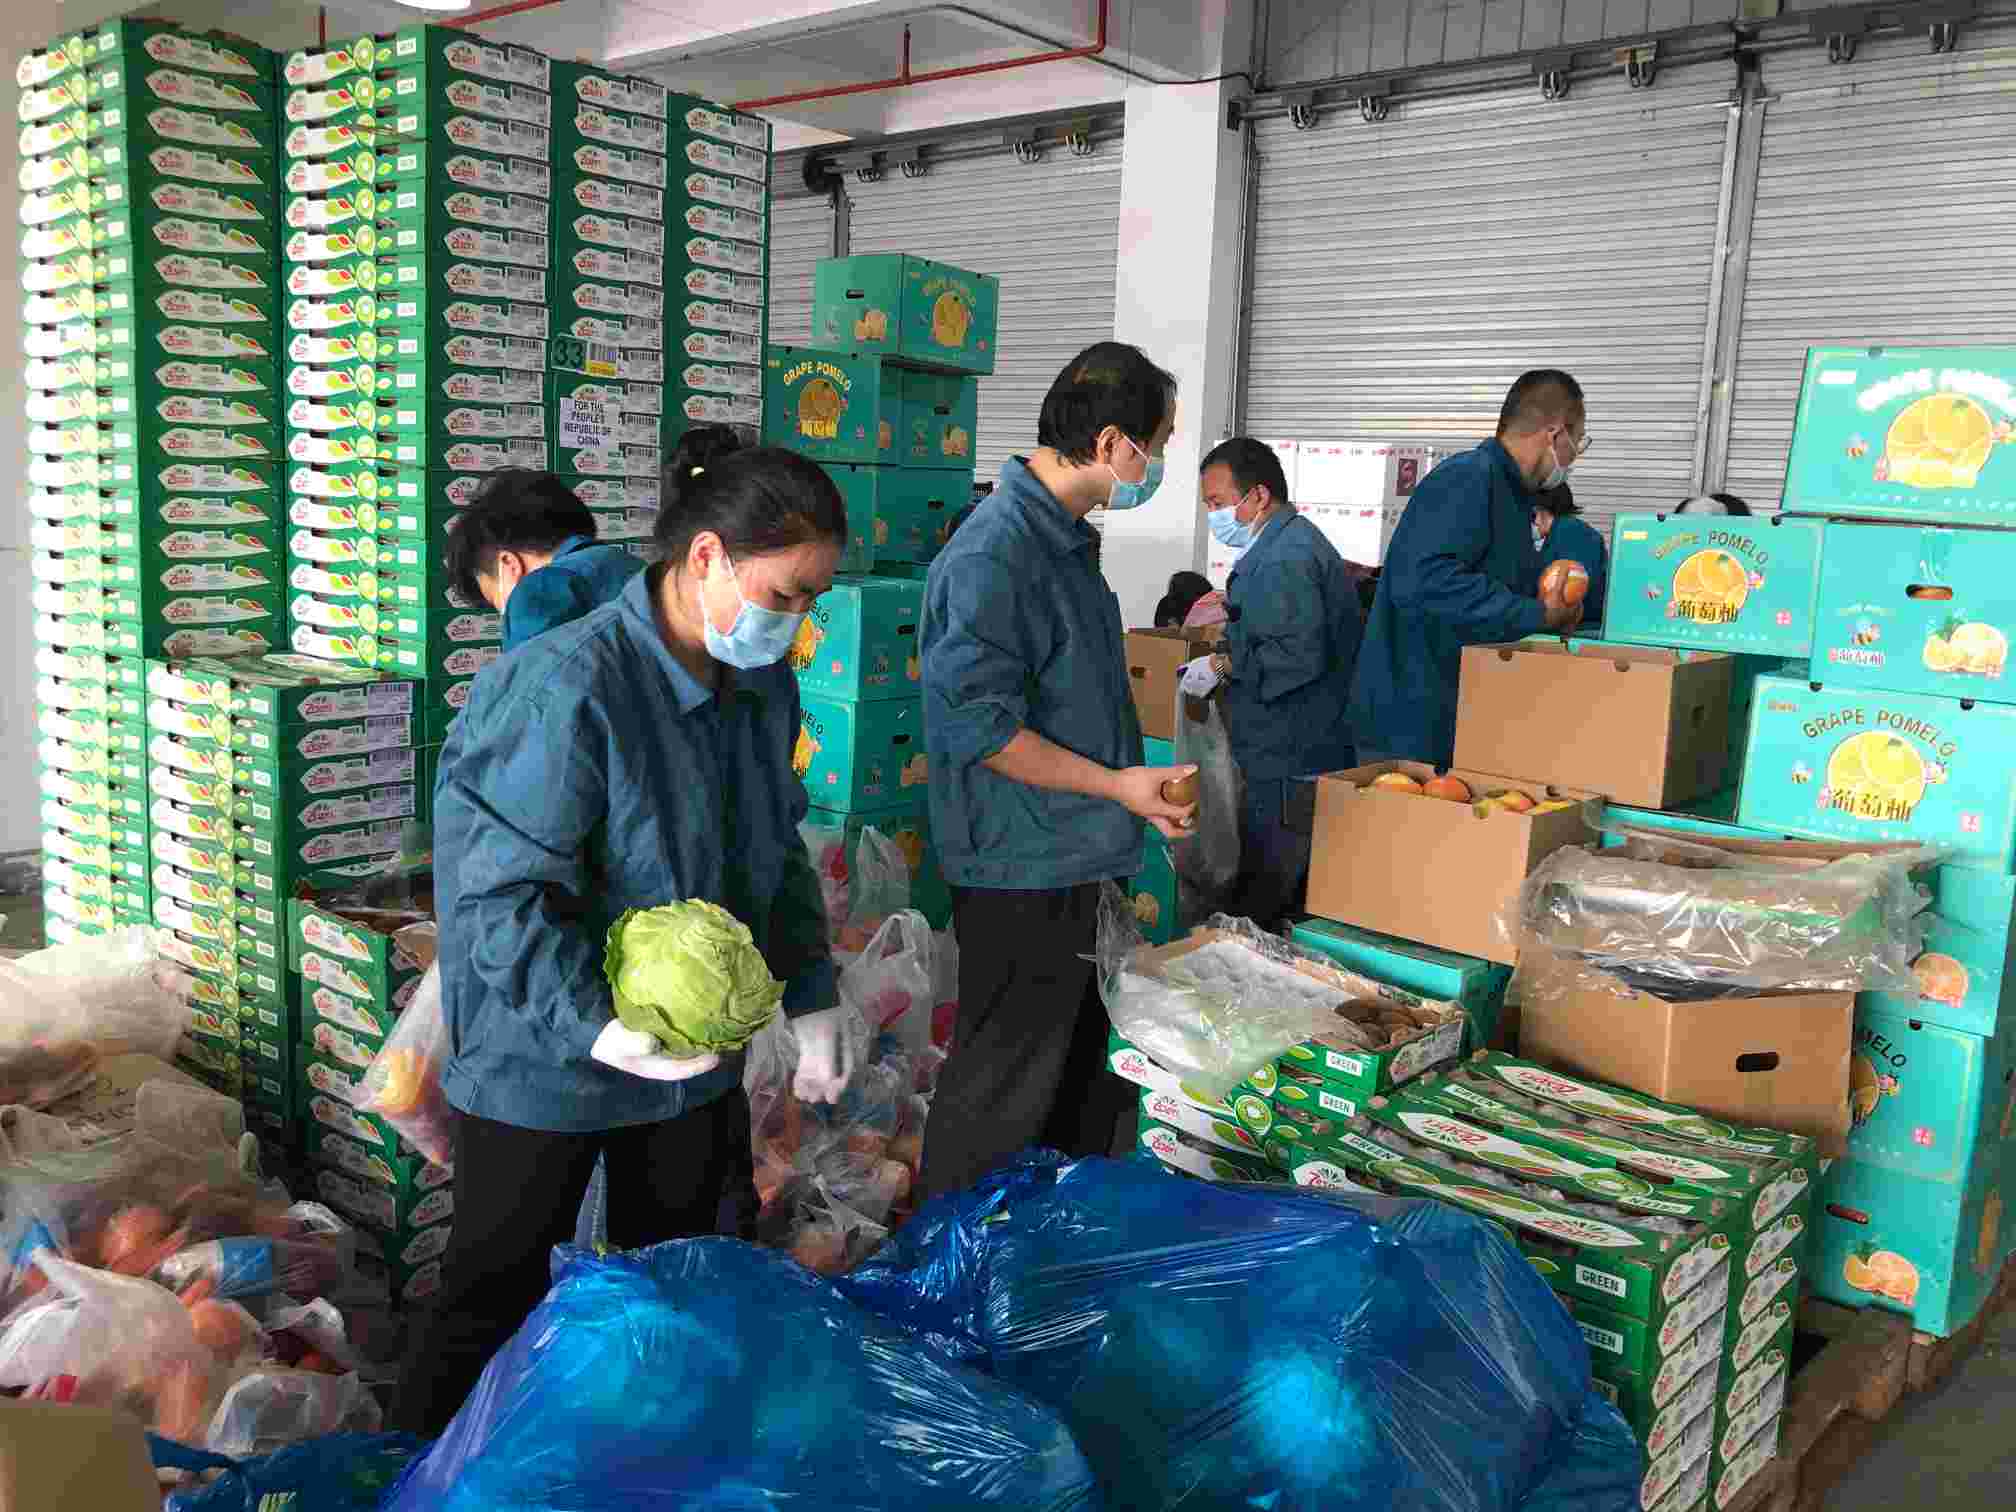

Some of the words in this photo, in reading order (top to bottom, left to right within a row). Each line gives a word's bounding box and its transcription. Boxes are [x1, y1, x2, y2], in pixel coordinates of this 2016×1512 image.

[551, 340, 585, 368] 33
[784, 361, 815, 386] GRAPE
[1708, 529, 1769, 566] POMELO
[1803, 708, 1865, 739] GRAPE
[1876, 709, 1957, 757] POMELO
[1329, 1055, 1358, 1074] GREEN
[1323, 1096, 1350, 1114] GREEN
[1582, 1270, 1620, 1292] GREEN
